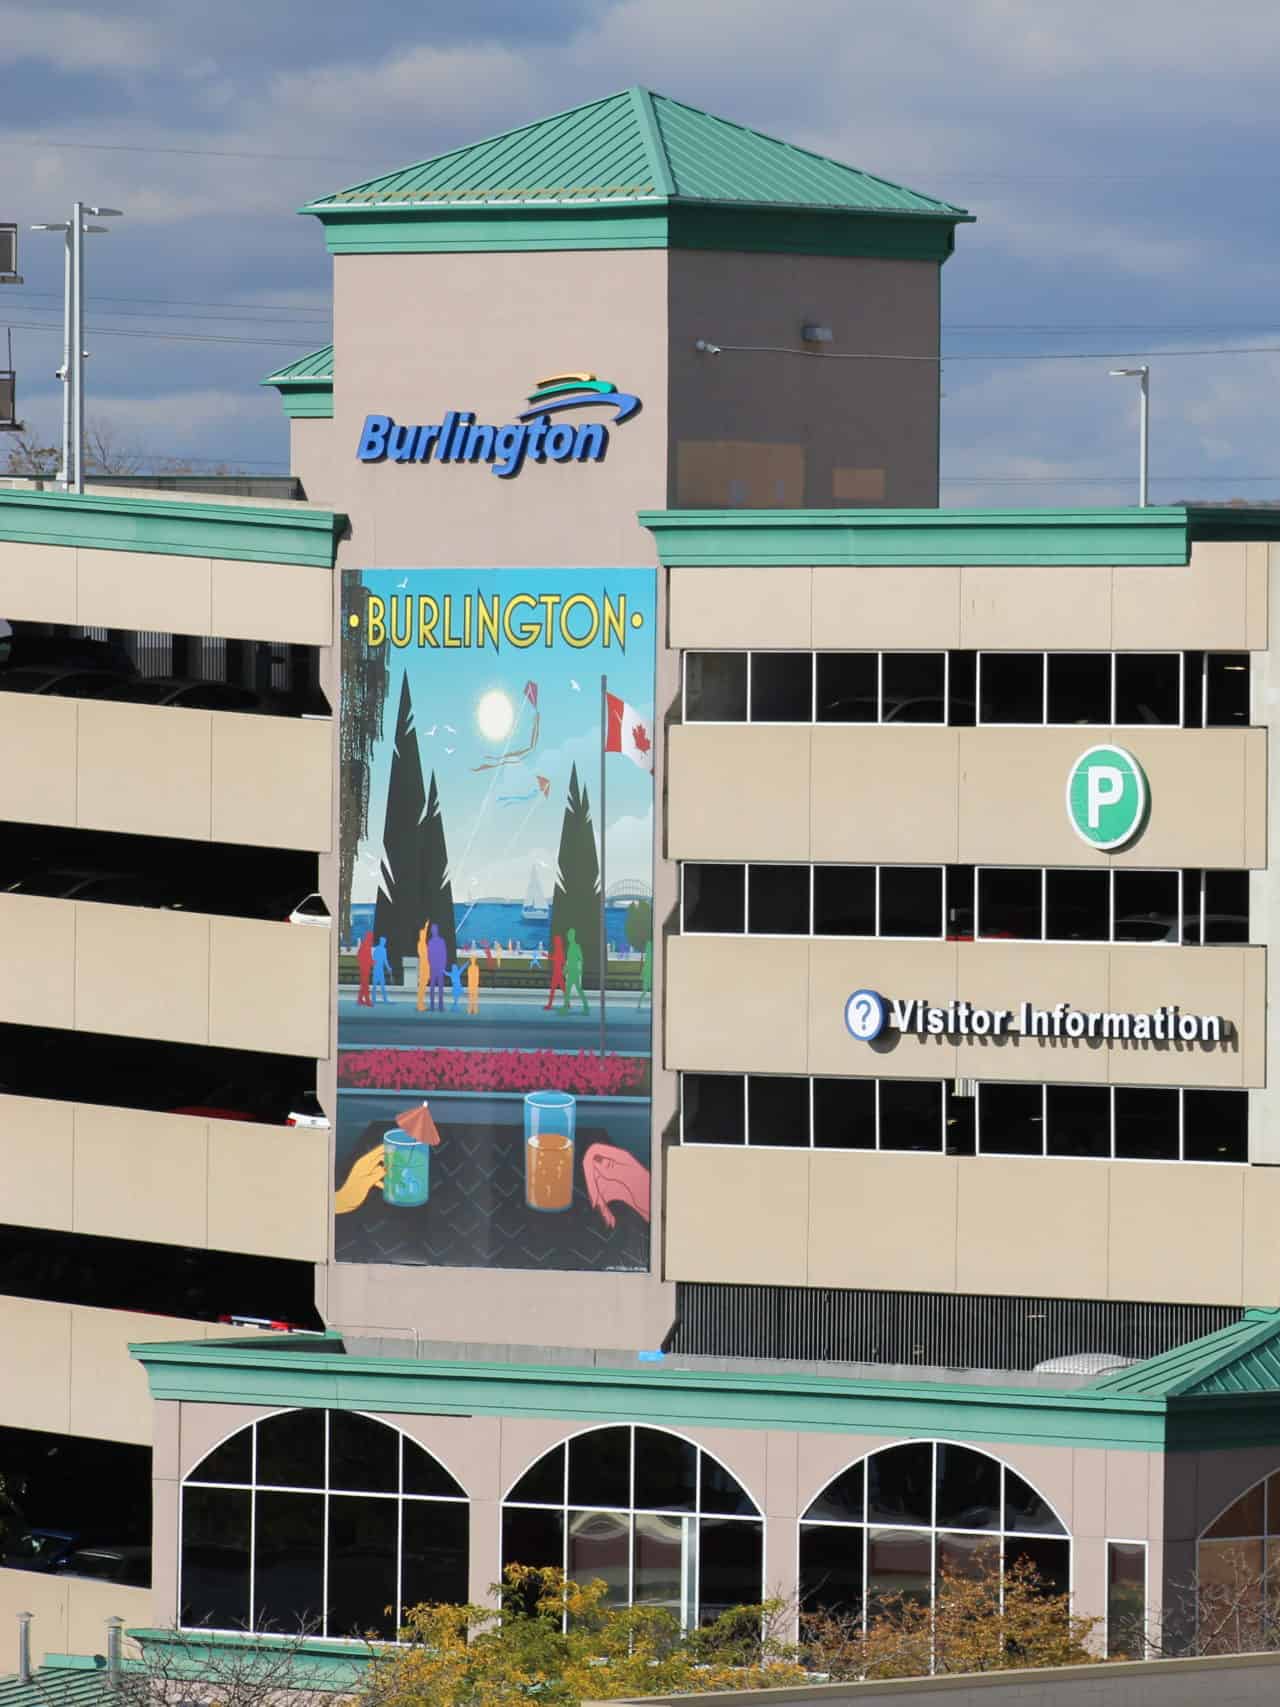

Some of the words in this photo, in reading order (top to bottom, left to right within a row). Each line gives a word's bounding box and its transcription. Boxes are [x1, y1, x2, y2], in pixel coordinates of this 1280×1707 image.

[356, 411, 608, 478] Burlington
[366, 588, 629, 655] BURLINGTON
[1087, 766, 1124, 828] P
[891, 1000, 1011, 1034] Visitor
[1020, 1003, 1221, 1041] Information
